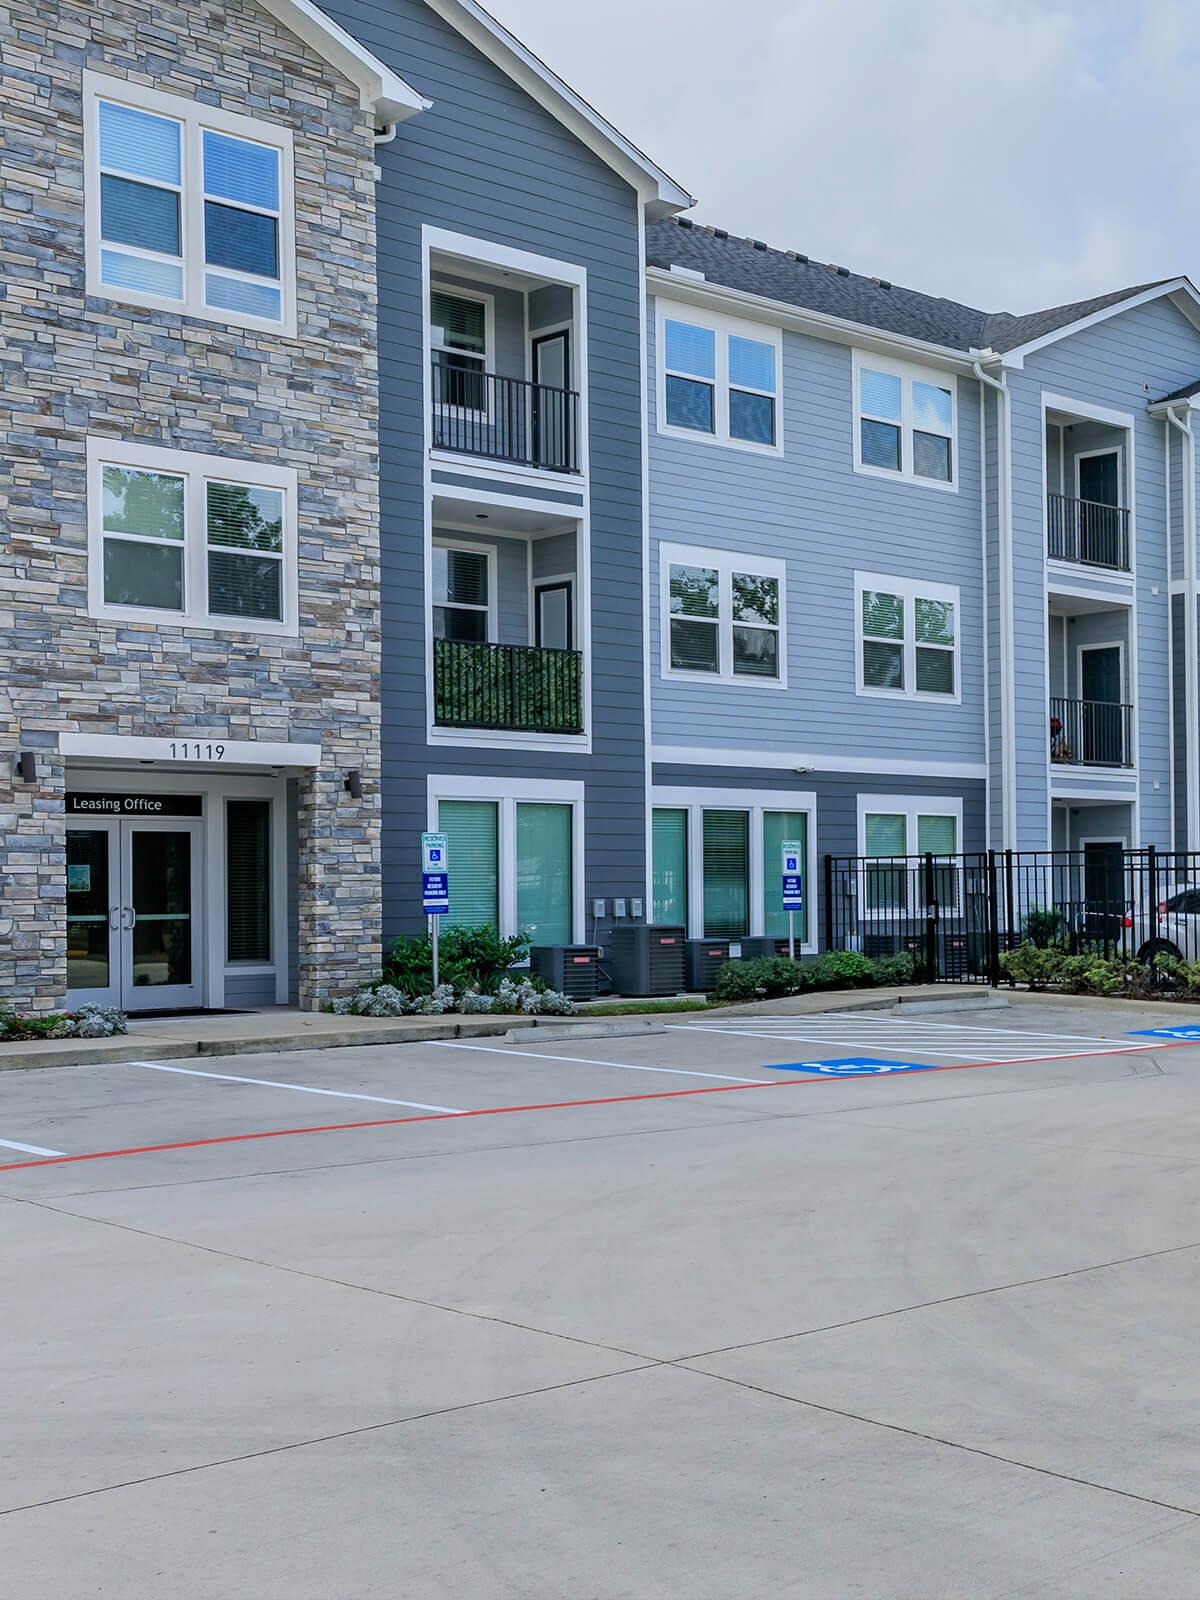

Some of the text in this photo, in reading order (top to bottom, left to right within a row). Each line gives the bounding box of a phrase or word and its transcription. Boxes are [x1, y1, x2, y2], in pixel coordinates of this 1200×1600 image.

[170, 743, 225, 760] 11119
[73, 798, 162, 812] Leasing Office
